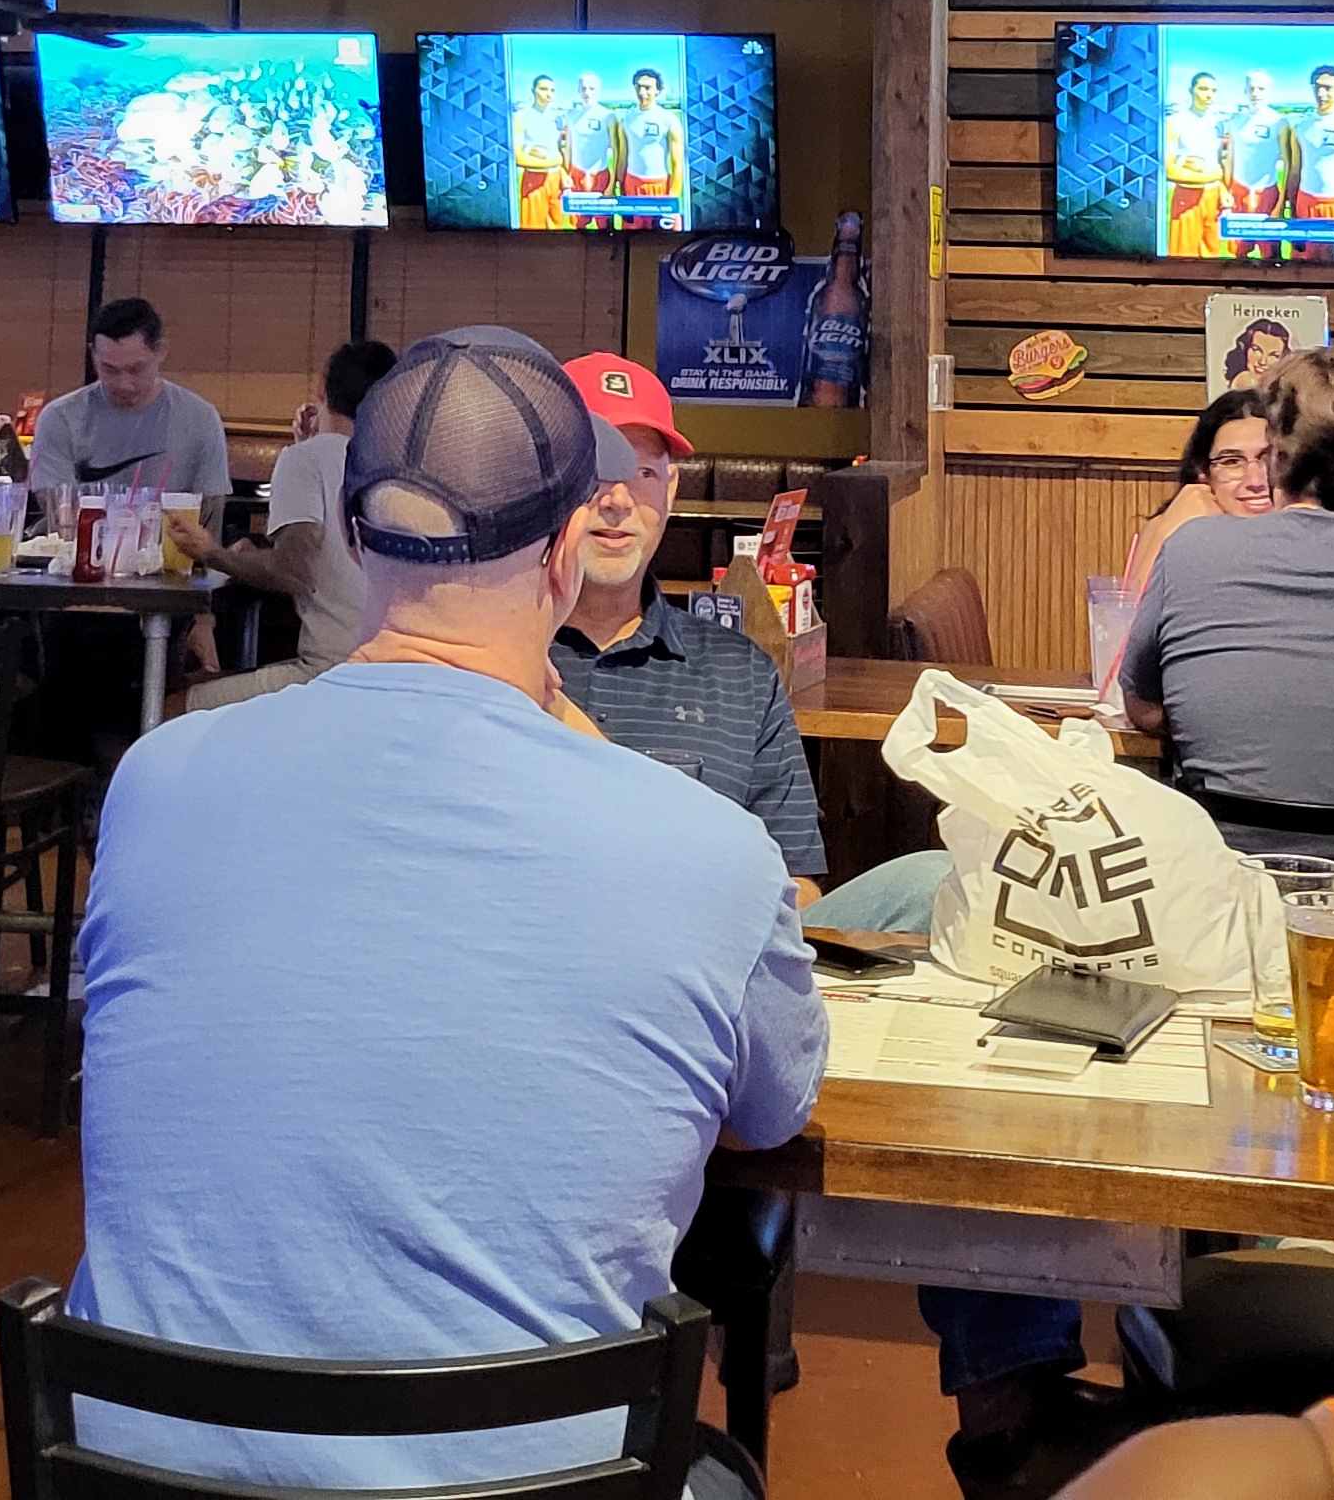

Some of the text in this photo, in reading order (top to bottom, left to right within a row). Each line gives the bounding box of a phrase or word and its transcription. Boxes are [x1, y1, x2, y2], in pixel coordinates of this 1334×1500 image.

[705, 242, 779, 263] BUD
[688, 264, 789, 282] LIGHT
[1233, 303, 1300, 319] Heineken
[819, 319, 862, 336] BUD
[811, 331, 864, 349] LIGHT
[703, 346, 768, 365] XLIX
[1013, 337, 1071, 370] Burgers
[680, 368, 704, 377] STAY
[708, 368, 719, 377] IN
[721, 368, 743, 378] THE
[670, 377, 789, 391] DRINK RESPONSIBLY.
[992, 932, 1159, 972] CONCEPTS
[989, 965, 1024, 982] squar
